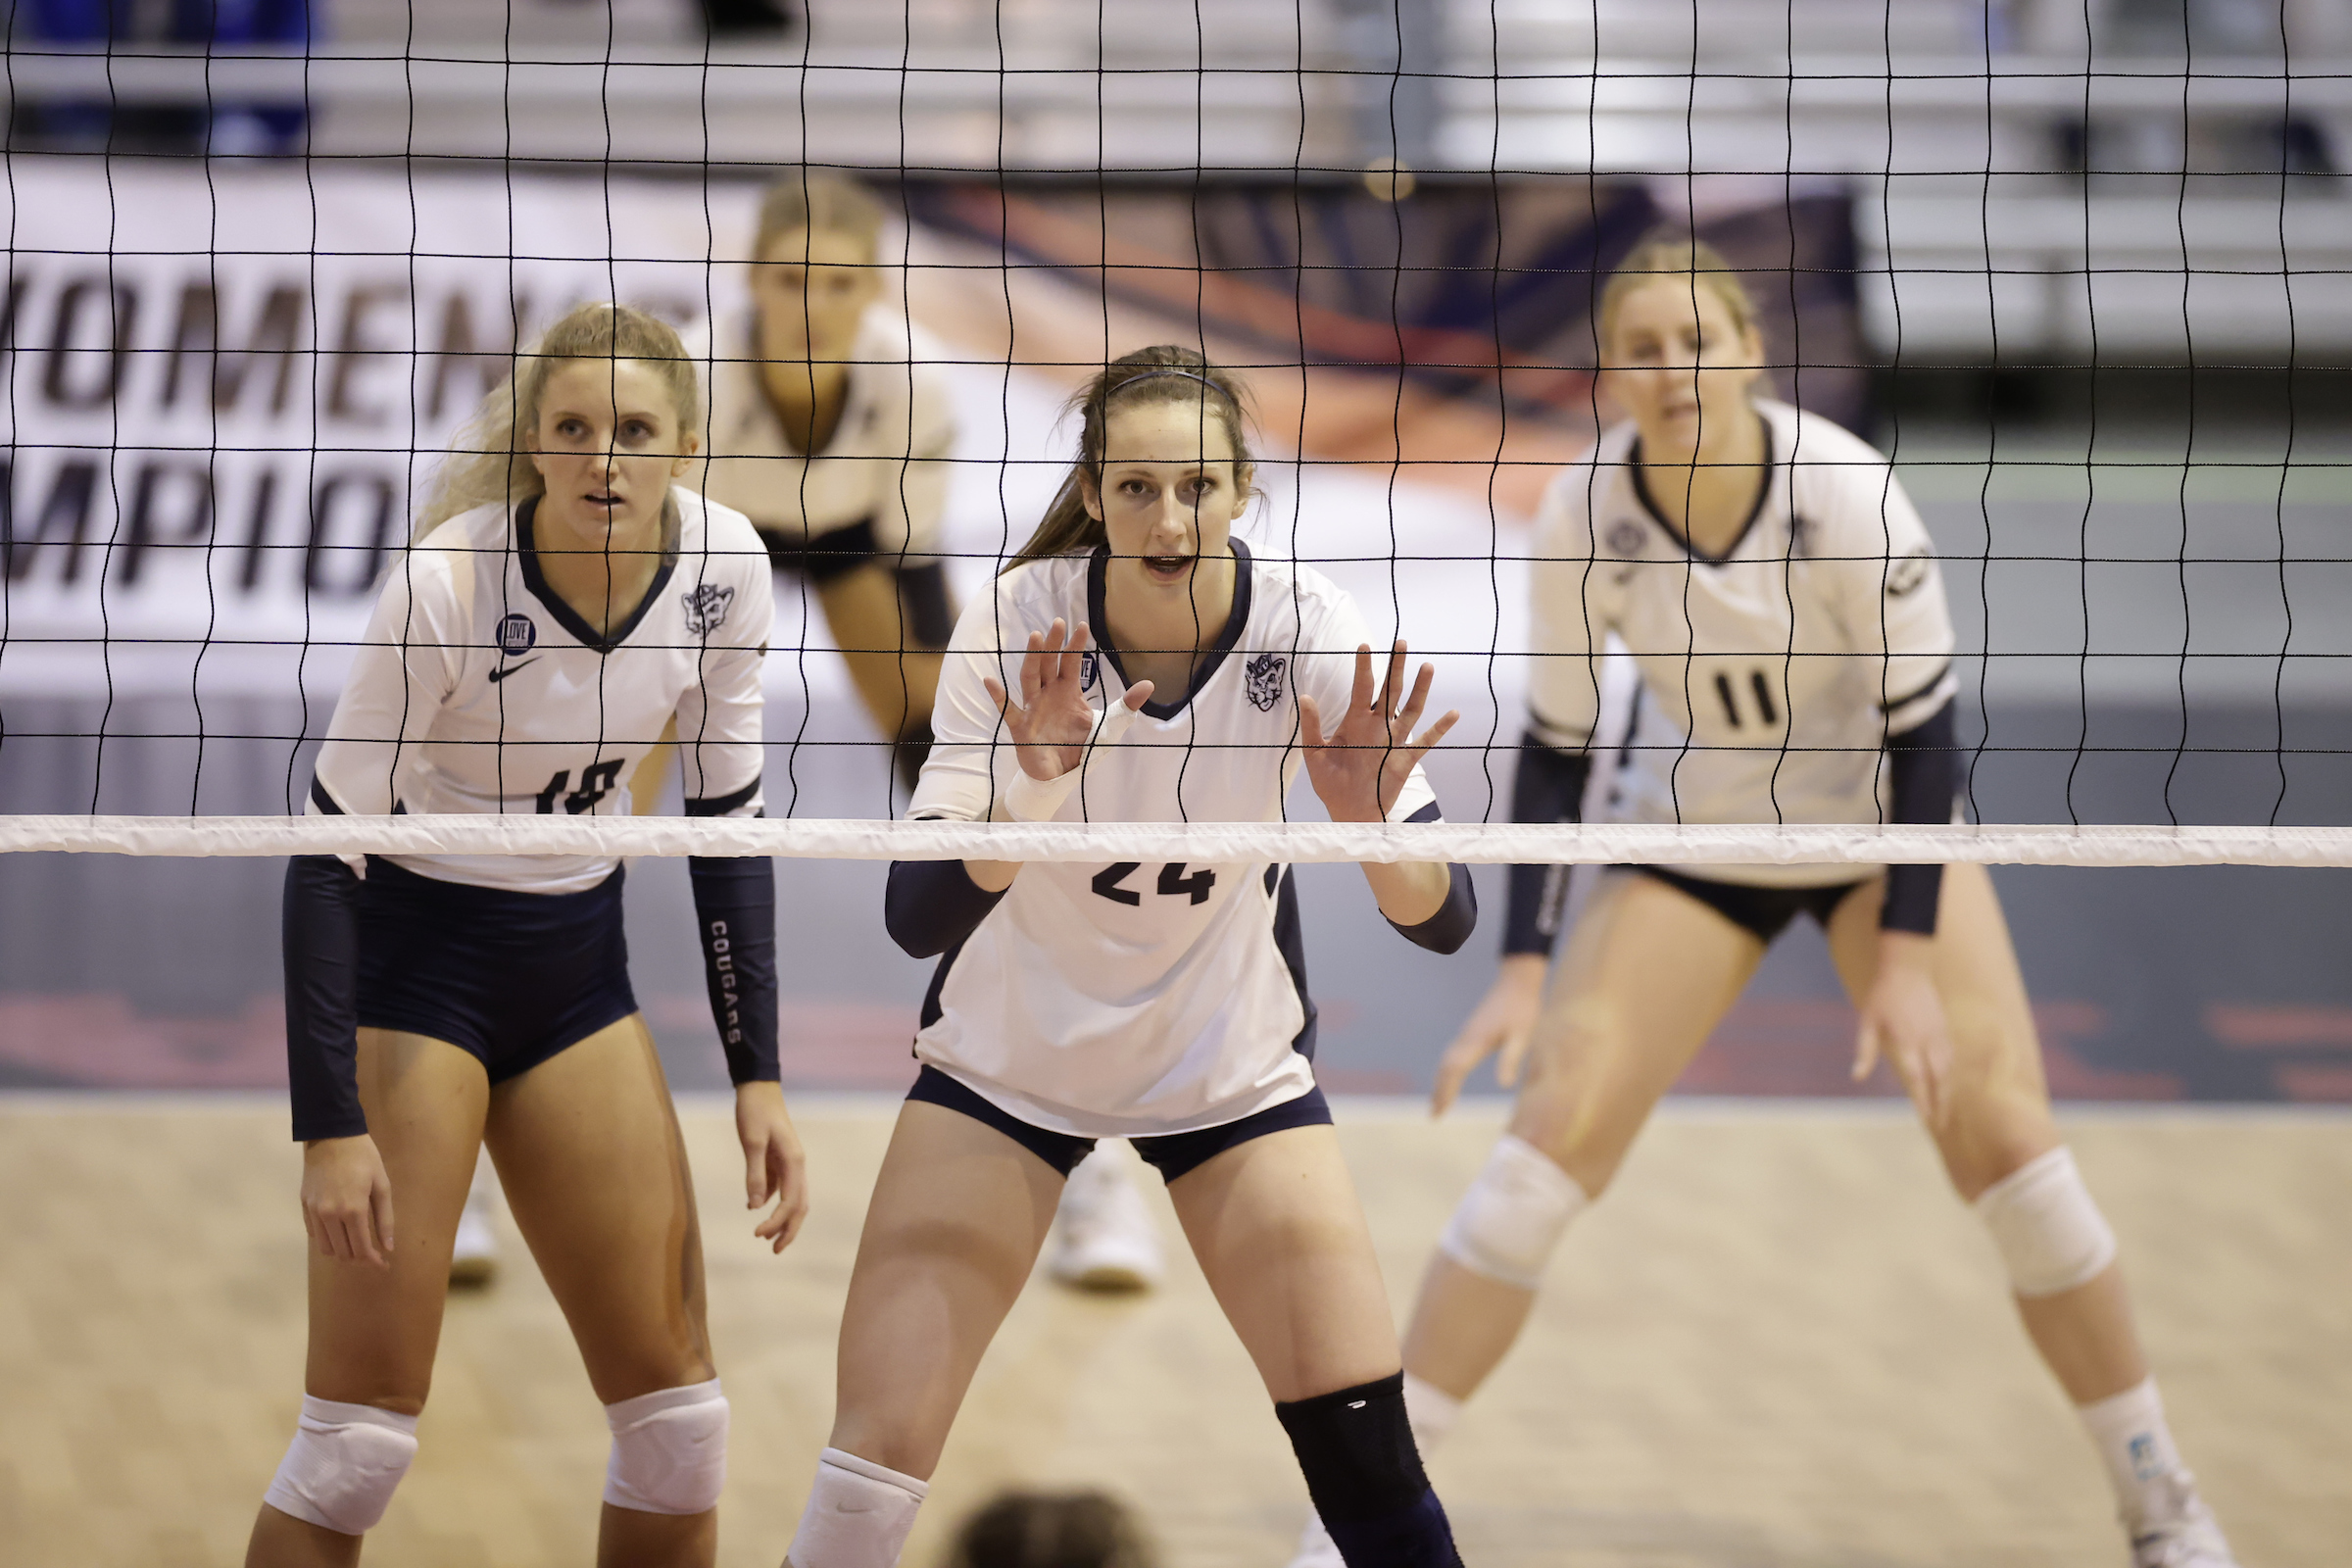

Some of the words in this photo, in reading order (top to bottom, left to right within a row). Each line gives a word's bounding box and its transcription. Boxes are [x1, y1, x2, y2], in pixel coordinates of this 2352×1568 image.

[1713, 670, 1779, 728] 11
[1092, 861, 1215, 906] 24
[710, 920, 741, 1045] COUGARS
